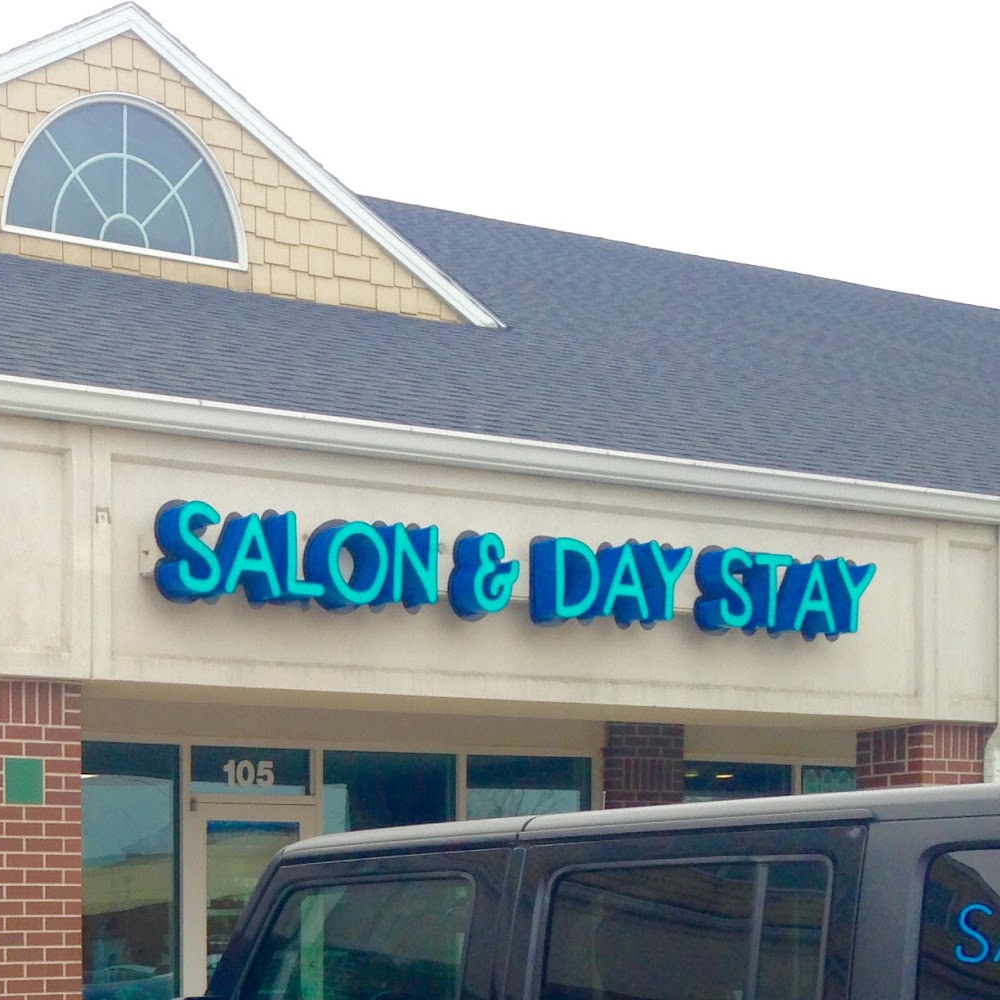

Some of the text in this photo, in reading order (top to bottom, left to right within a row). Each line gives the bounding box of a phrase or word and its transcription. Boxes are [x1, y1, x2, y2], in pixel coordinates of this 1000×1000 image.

[158, 501, 876, 633] SALON & DAY STAY
[223, 759, 275, 788] 105
[956, 904, 1000, 963] S
